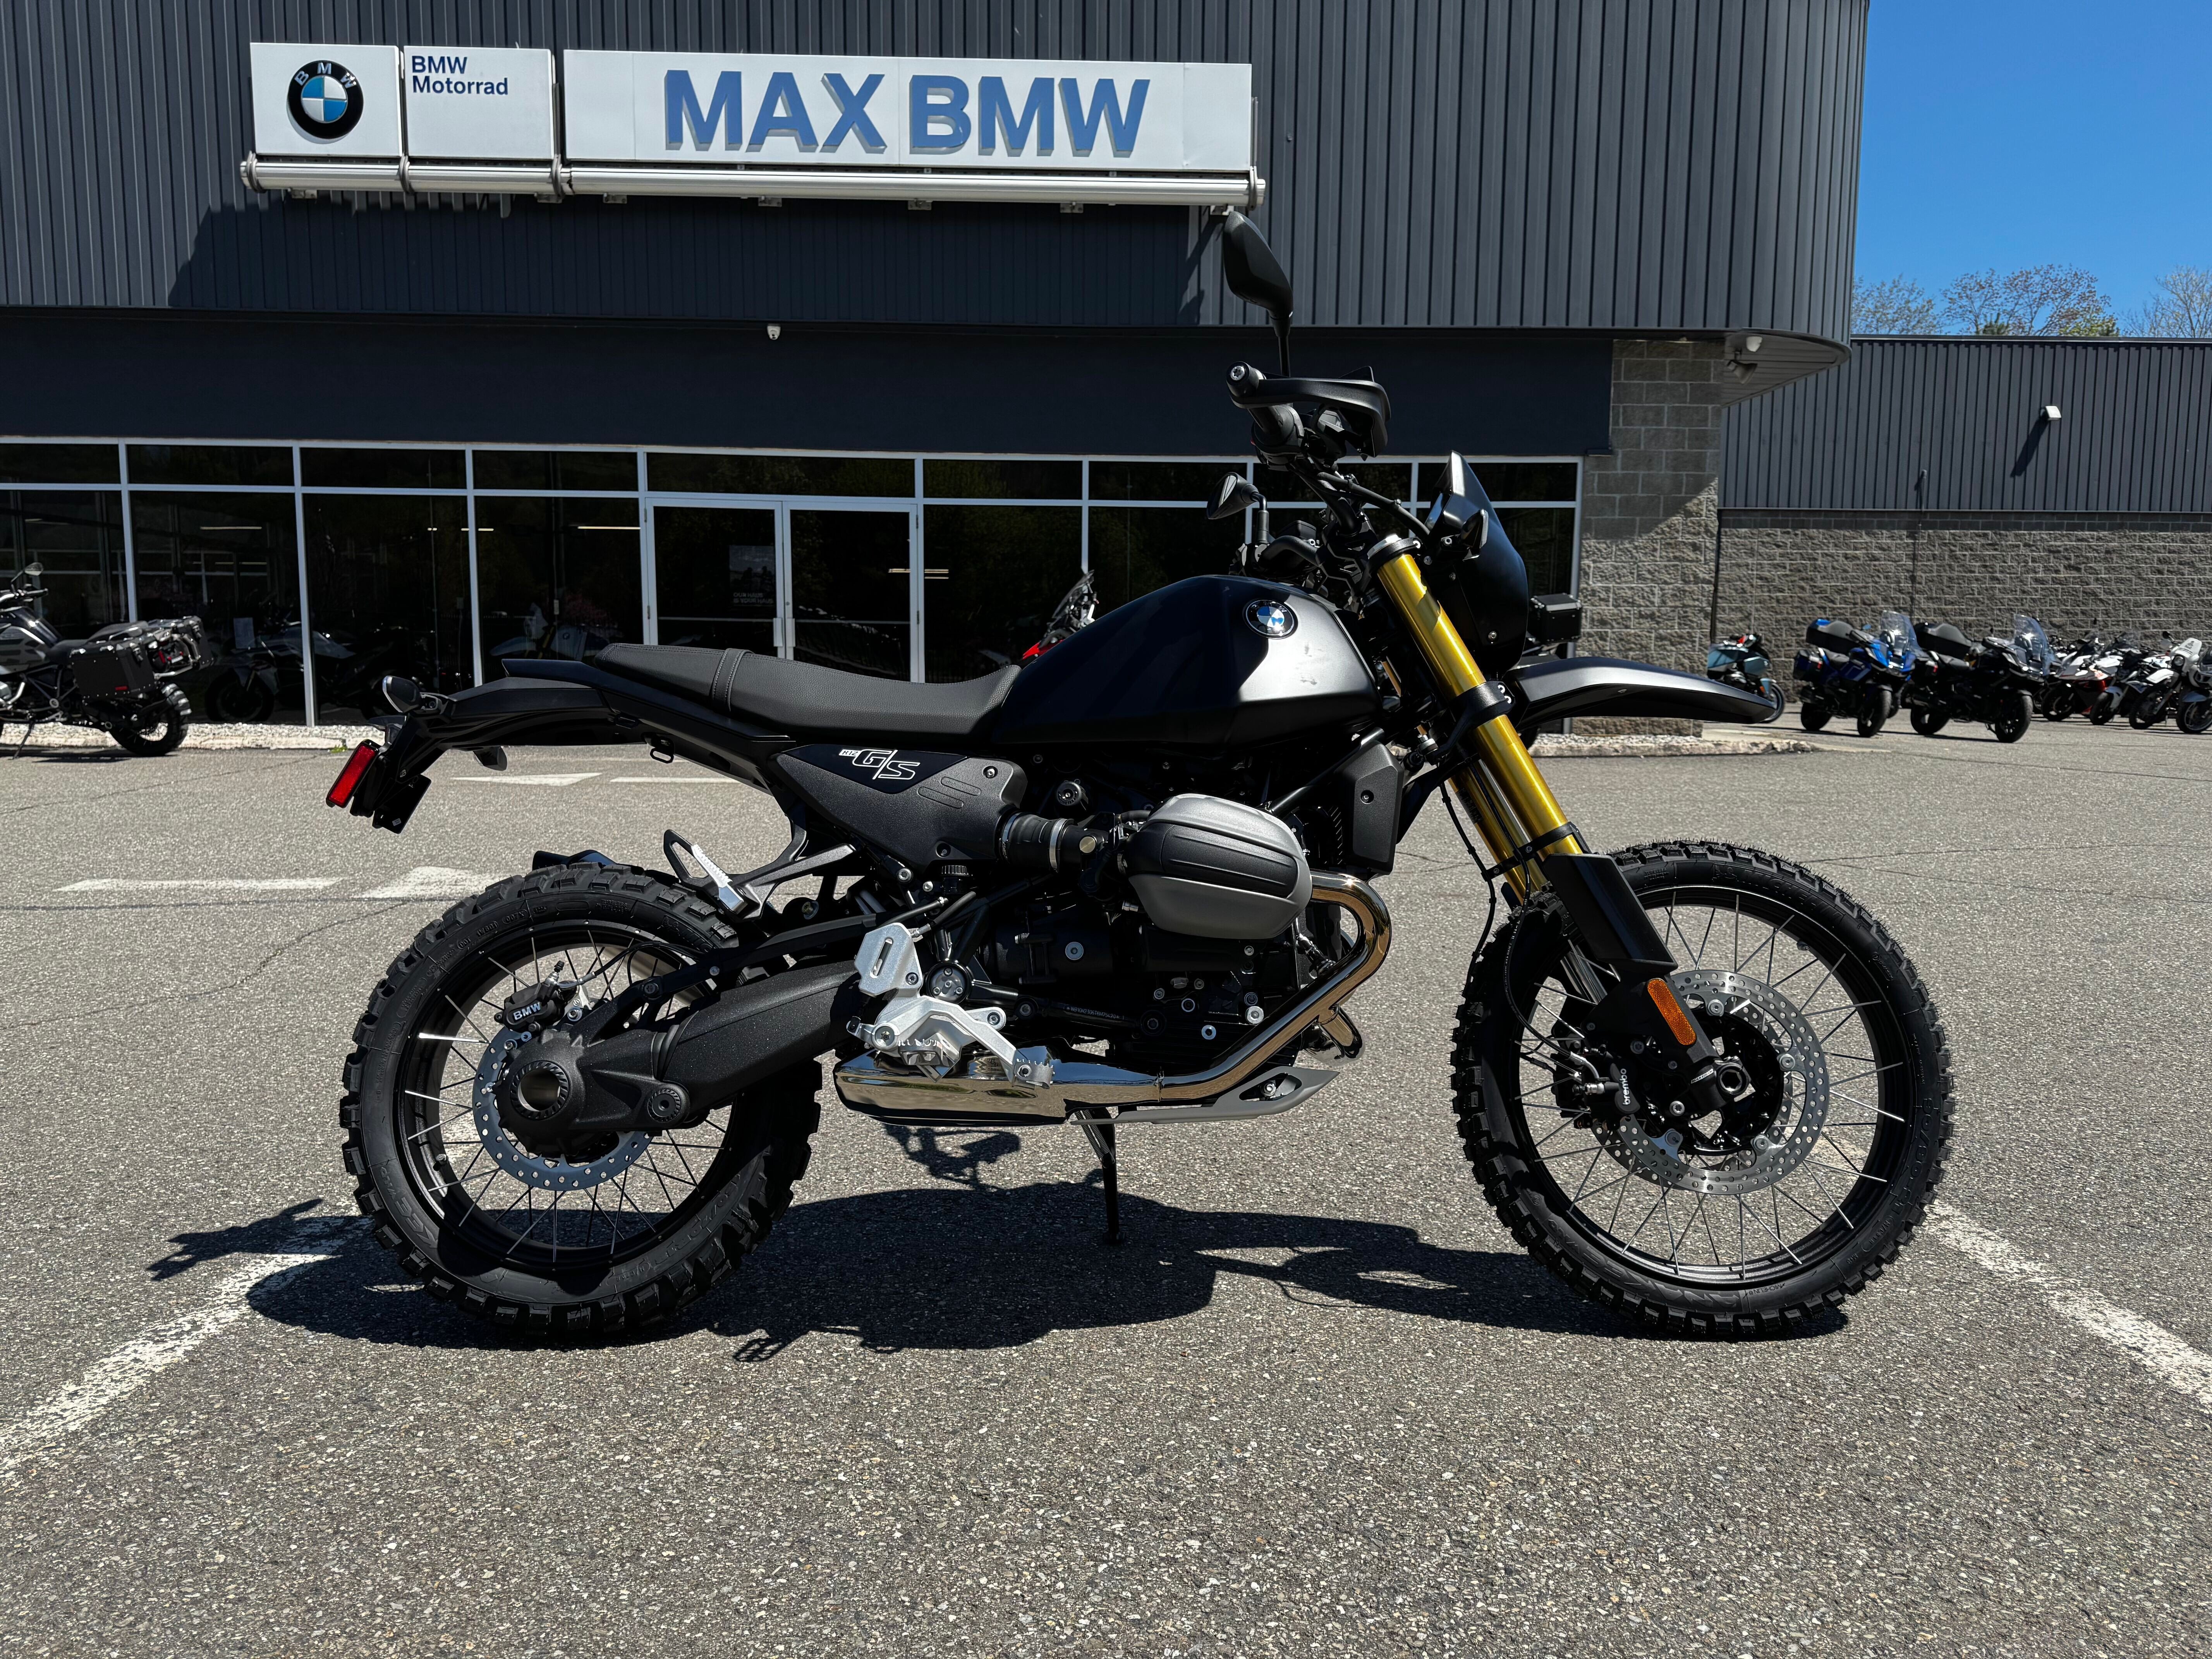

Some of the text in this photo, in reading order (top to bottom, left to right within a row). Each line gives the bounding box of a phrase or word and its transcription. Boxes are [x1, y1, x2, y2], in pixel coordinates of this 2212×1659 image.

[295, 62, 357, 89] BMW
[411, 55, 467, 75] BMW
[412, 76, 508, 95] Motorrad
[665, 70, 1151, 157] MAX BMW
[513, 1002, 541, 1022] BMW
[1619, 1068, 1631, 1105] brembo
